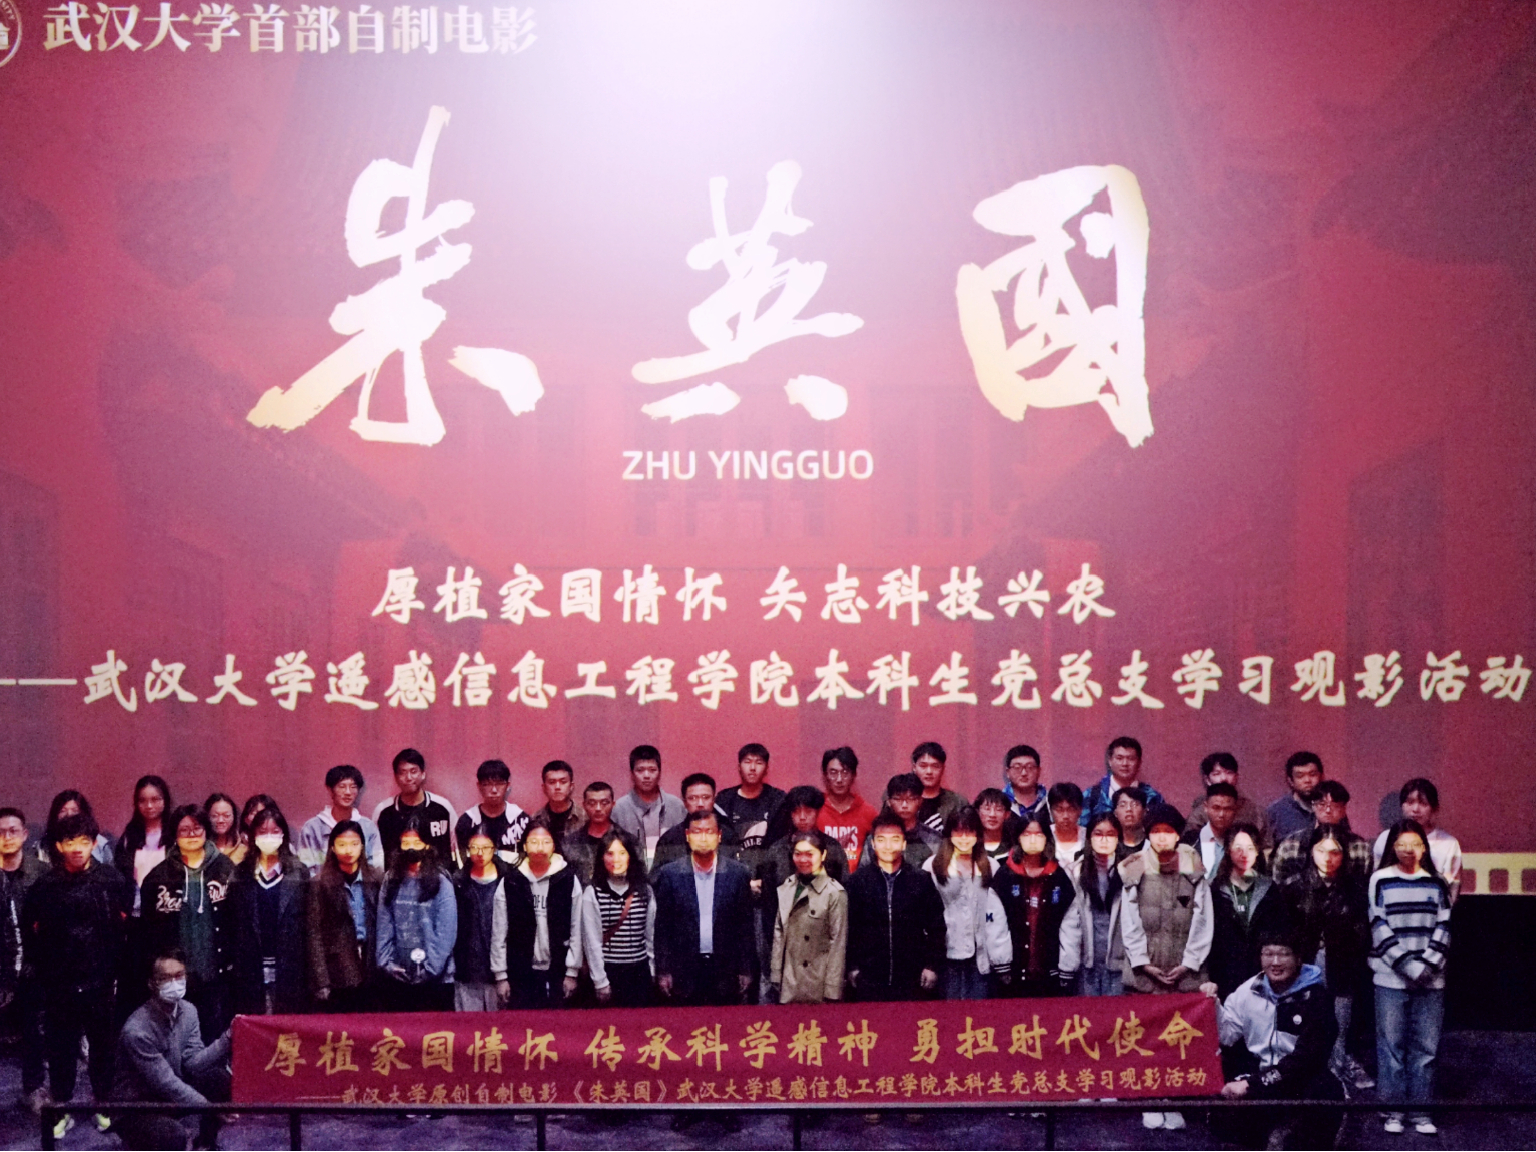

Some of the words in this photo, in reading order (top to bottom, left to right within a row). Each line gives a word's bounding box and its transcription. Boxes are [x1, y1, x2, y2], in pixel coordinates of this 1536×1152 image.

[43, 3, 538, 54] 武汉大学首部自制电影
[622, 450, 697, 481] ZHU
[707, 450, 874, 481] YINGGUO
[372, 563, 728, 625] 厚植家国情怀
[758, 563, 1116, 627] 矢志科技兴农
[265, 1028, 560, 1077] 厚植家国情怀
[583, 1020, 879, 1072] 传承科学精神
[909, 1010, 1204, 1065] 勇担时代使命
